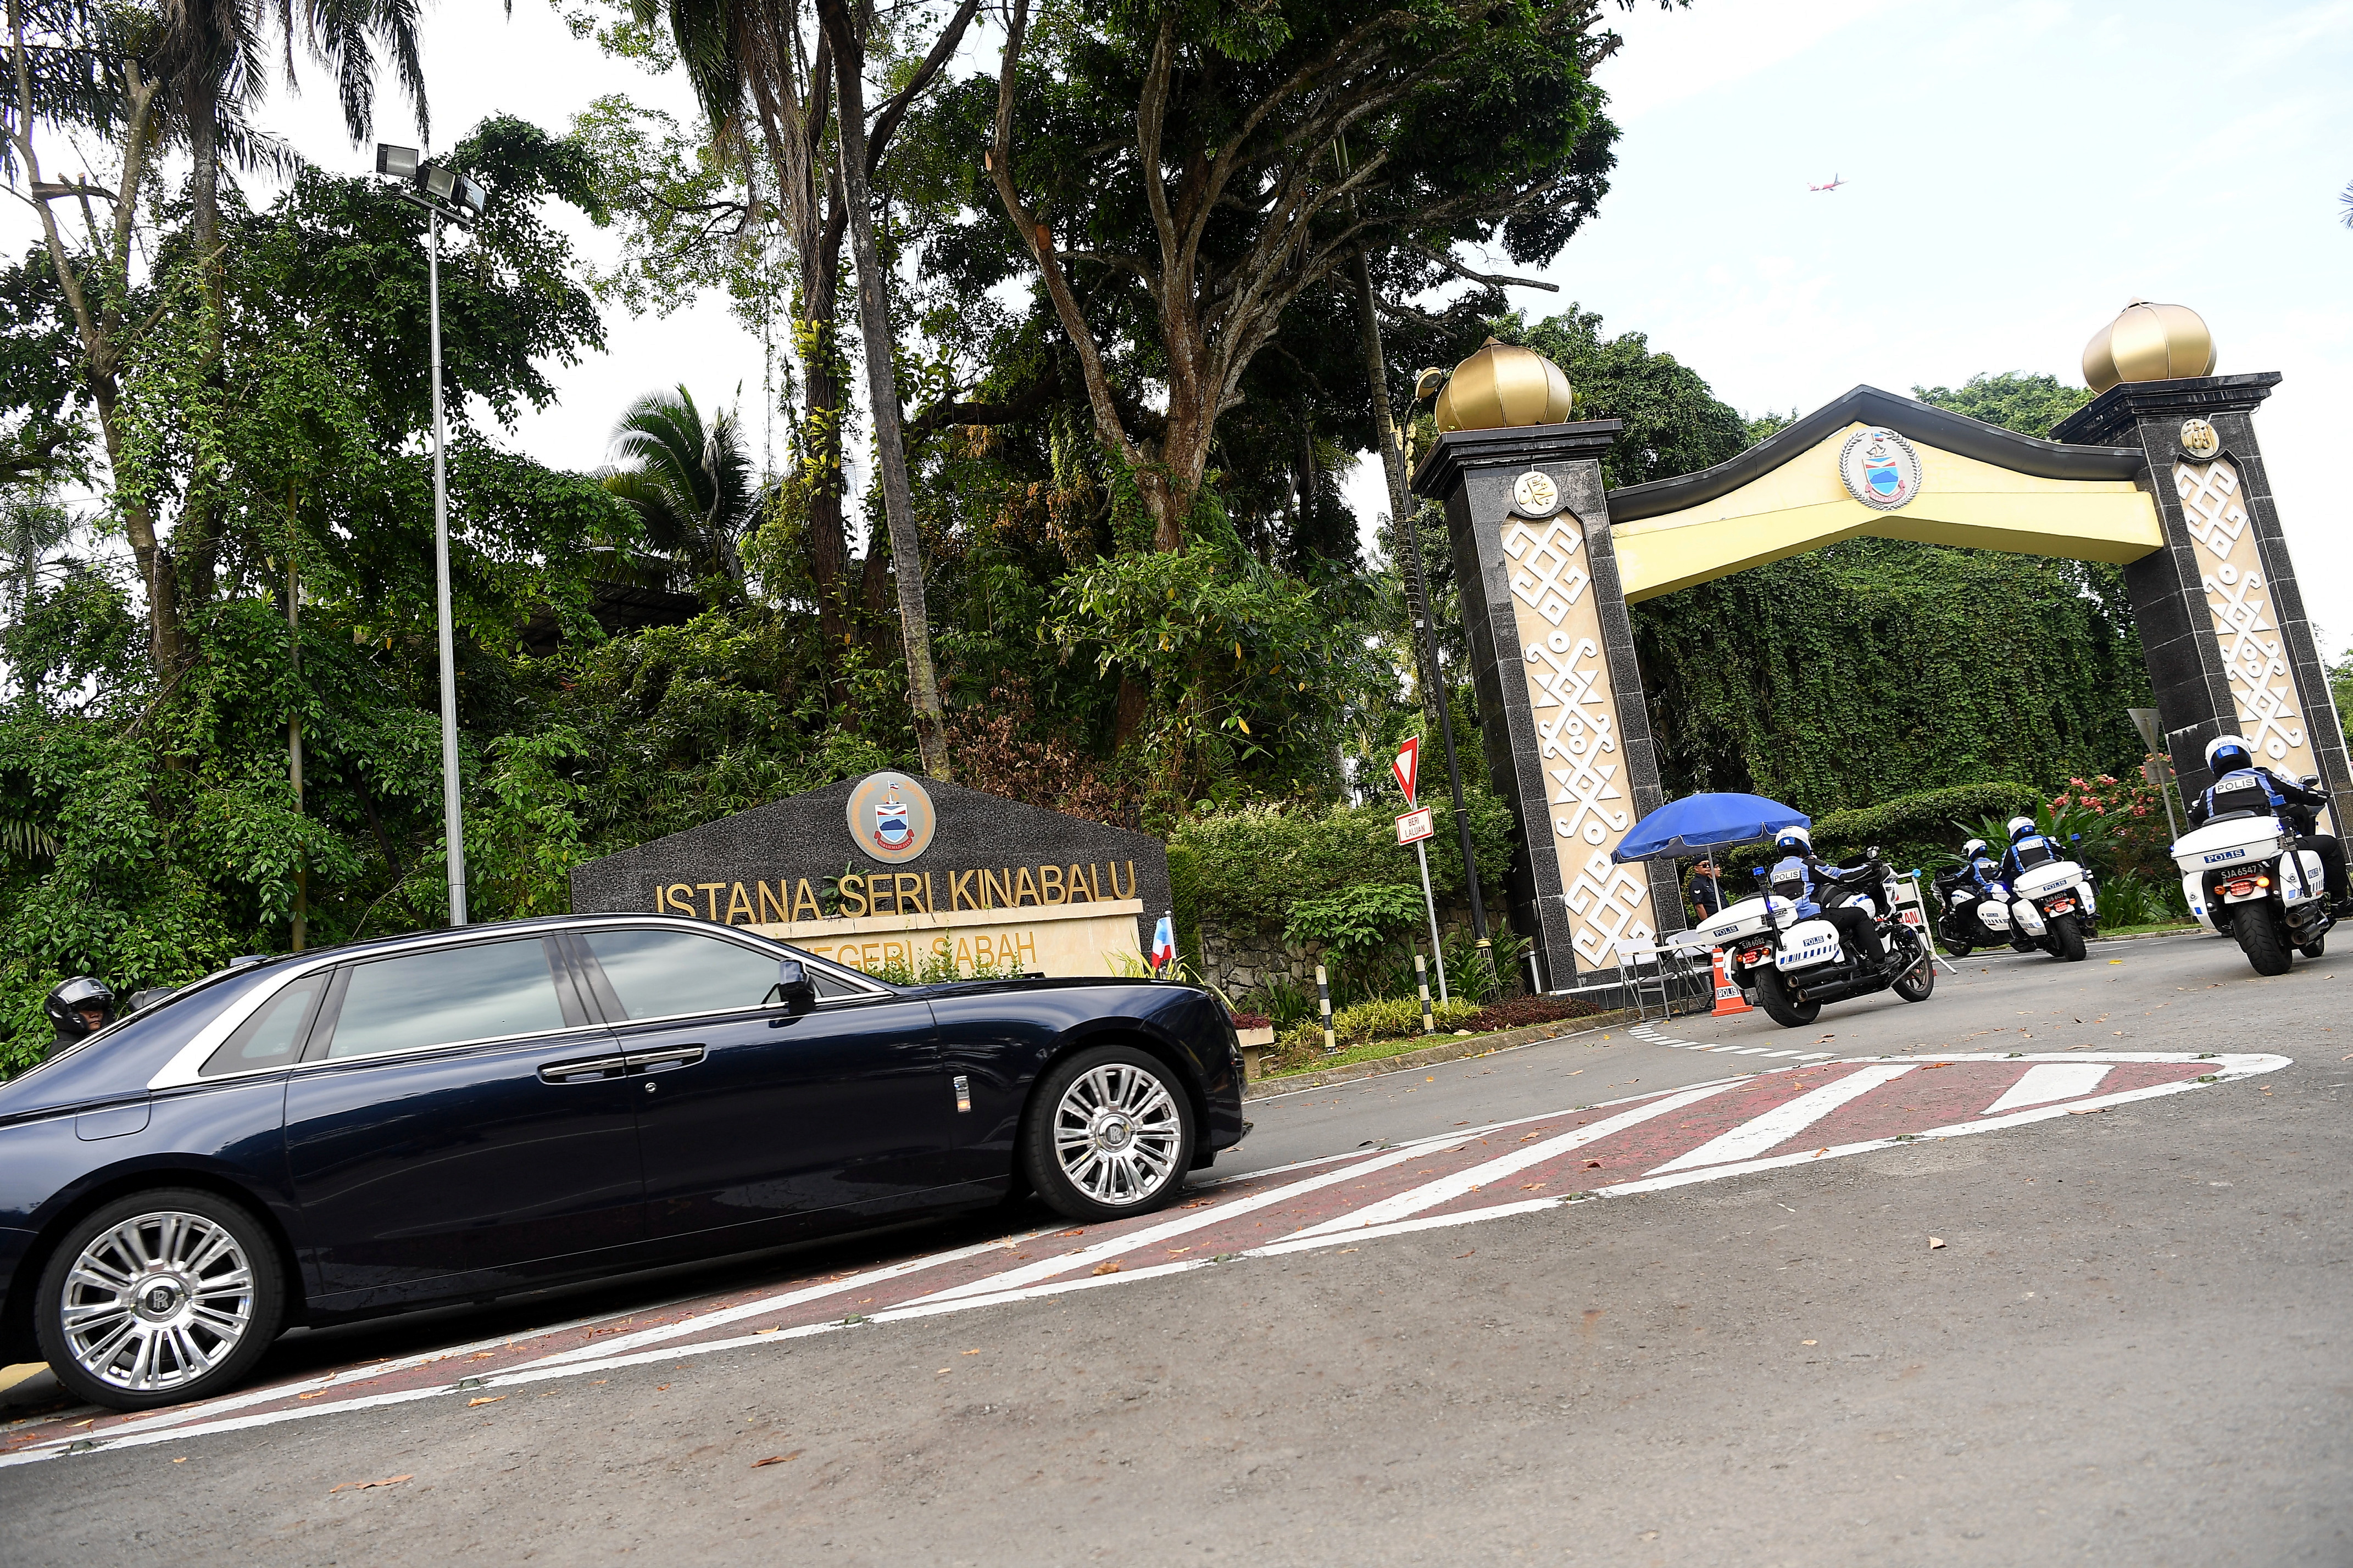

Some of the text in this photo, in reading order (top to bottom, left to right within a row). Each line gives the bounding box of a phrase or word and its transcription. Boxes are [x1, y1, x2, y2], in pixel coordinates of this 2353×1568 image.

[2218, 779, 2254, 792] POLIS
[1408, 816, 1419, 827] BERI
[1405, 824, 1425, 838] LALUAN
[2206, 850, 2243, 862] POLIS
[1775, 872, 1798, 881] POLIS
[2044, 880, 2066, 890] POLIS
[655, 861, 1136, 924] ISTANA SERI KINABALU
[1715, 927, 1737, 936] POLIS
[1804, 936, 1823, 946] POLIS
[932, 931, 1036, 970] SABAH
[1718, 988, 1738, 997] POLIS
